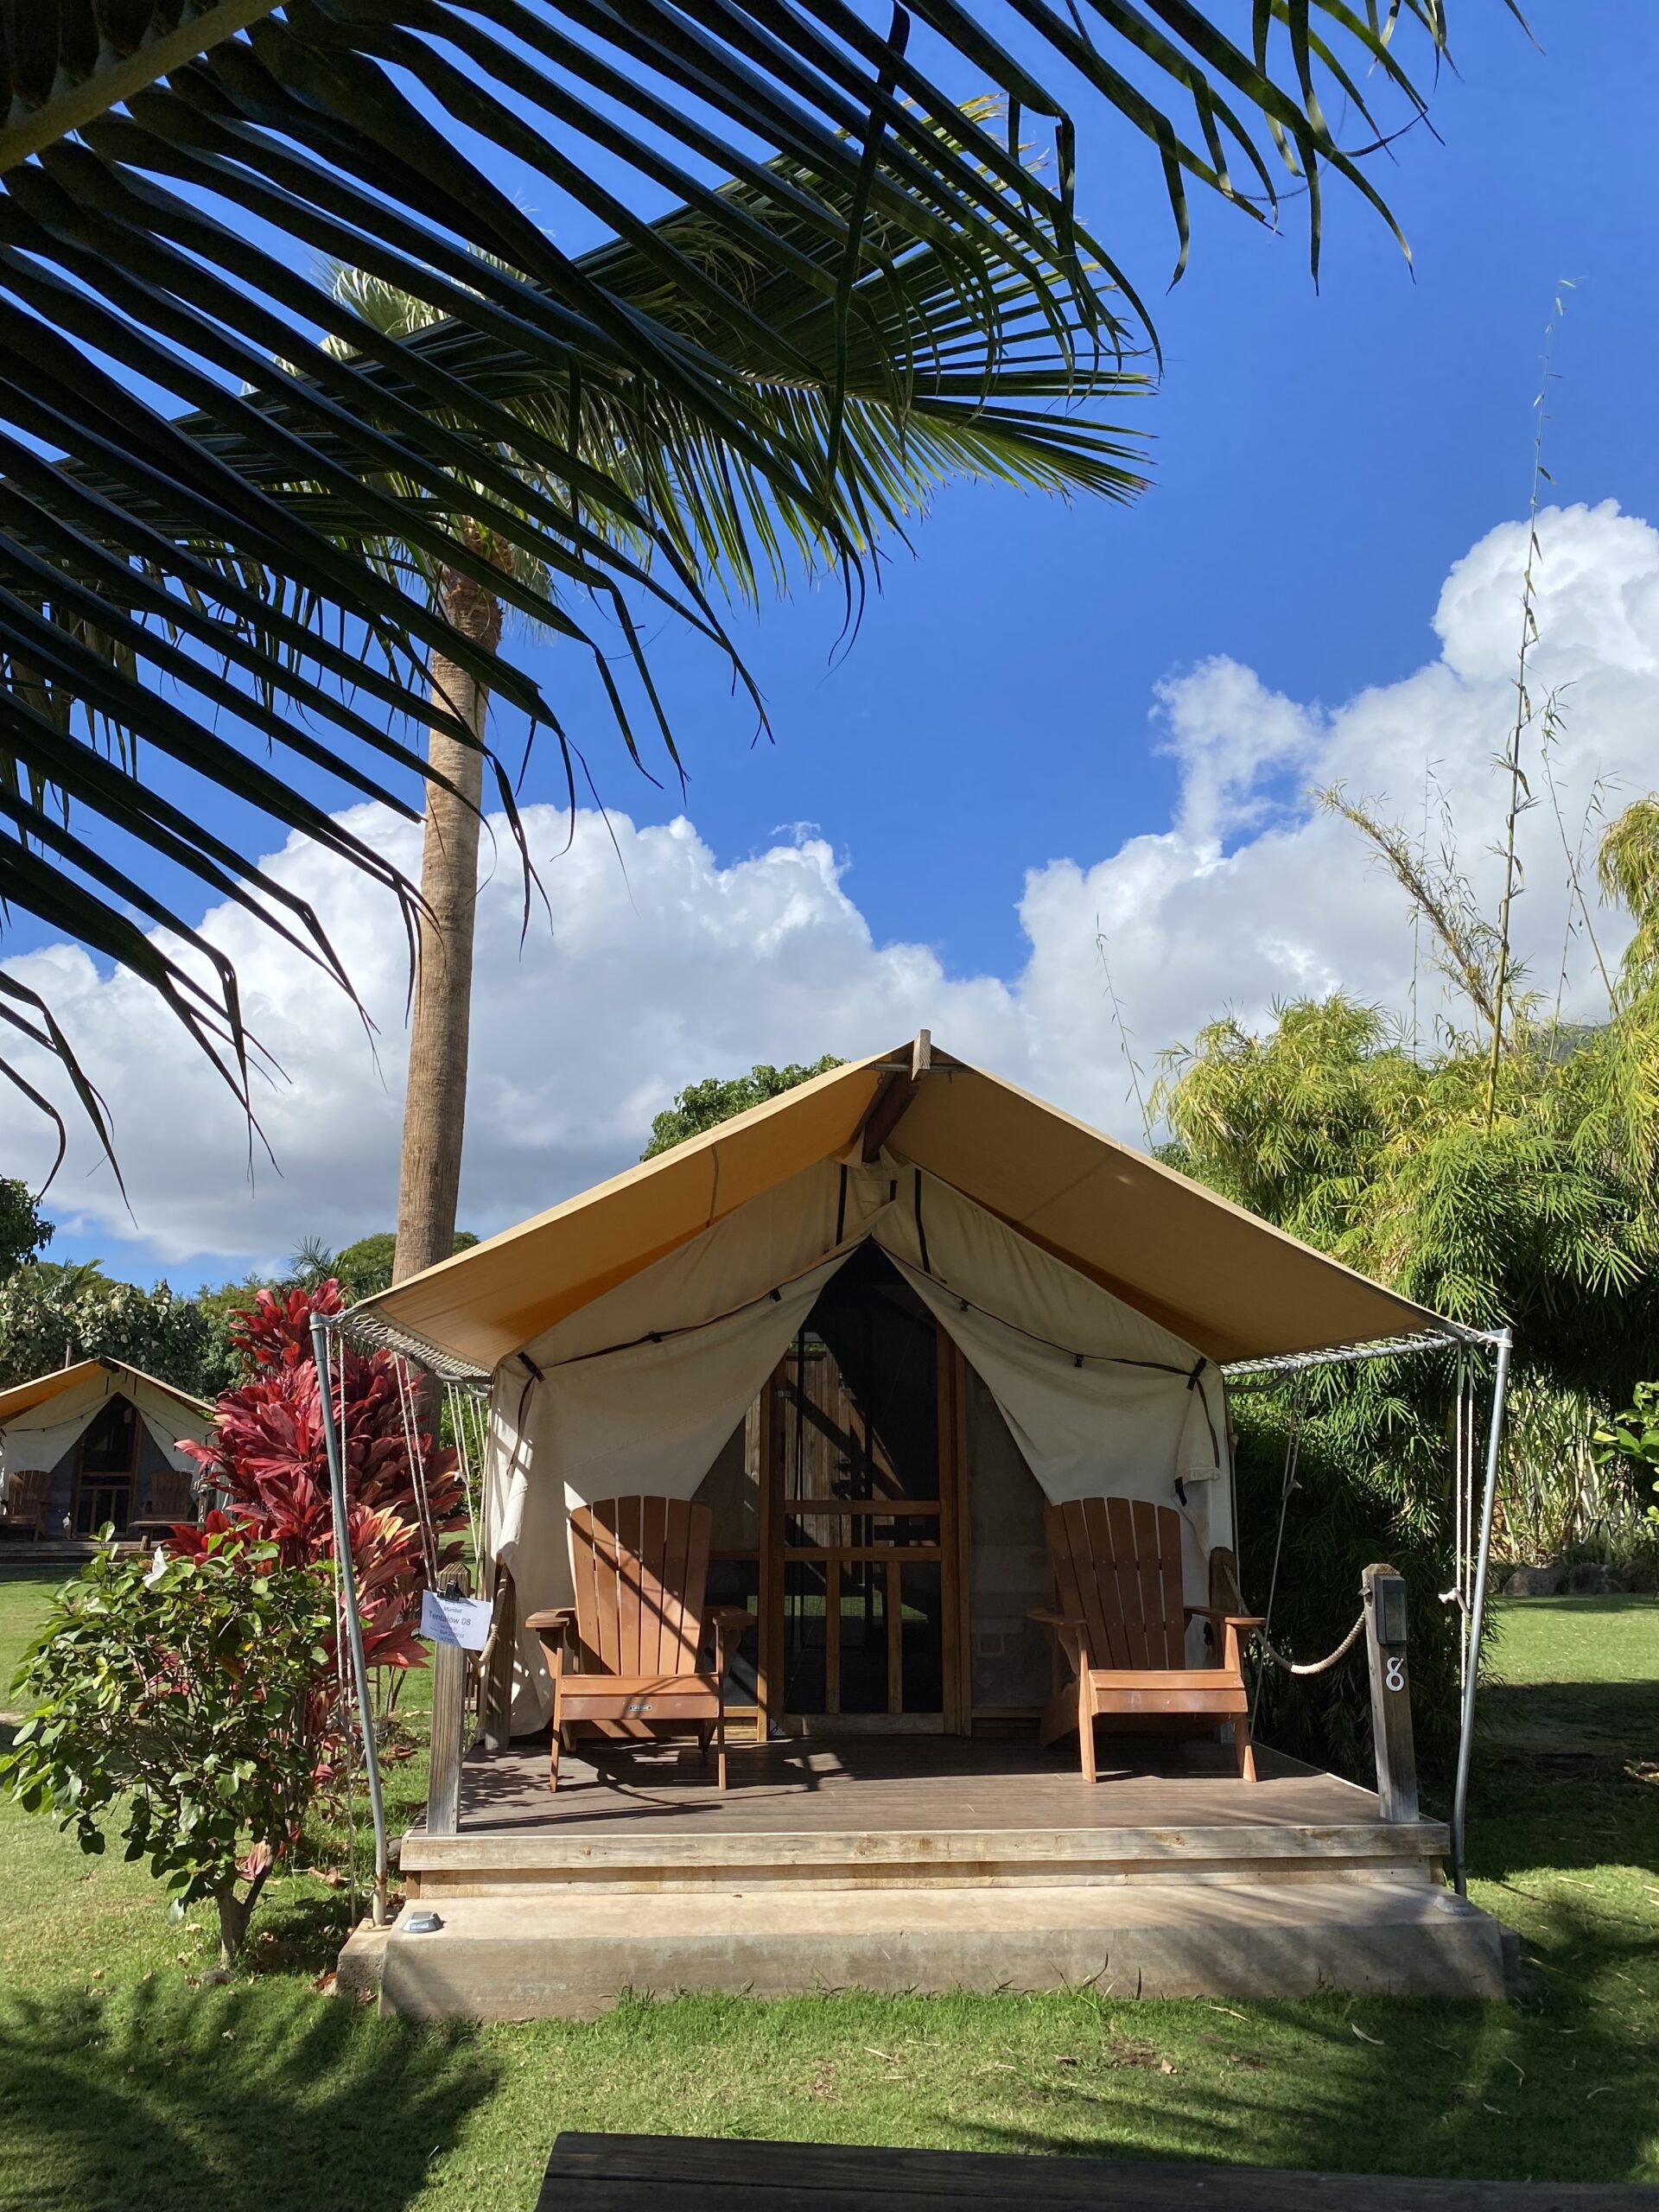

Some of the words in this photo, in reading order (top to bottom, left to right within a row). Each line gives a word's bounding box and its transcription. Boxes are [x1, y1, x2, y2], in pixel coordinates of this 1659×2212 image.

[429, 1611, 460, 1624] Tentalow
[461, 1618, 471, 1626] 08
[1386, 1656, 1404, 1692] 8
